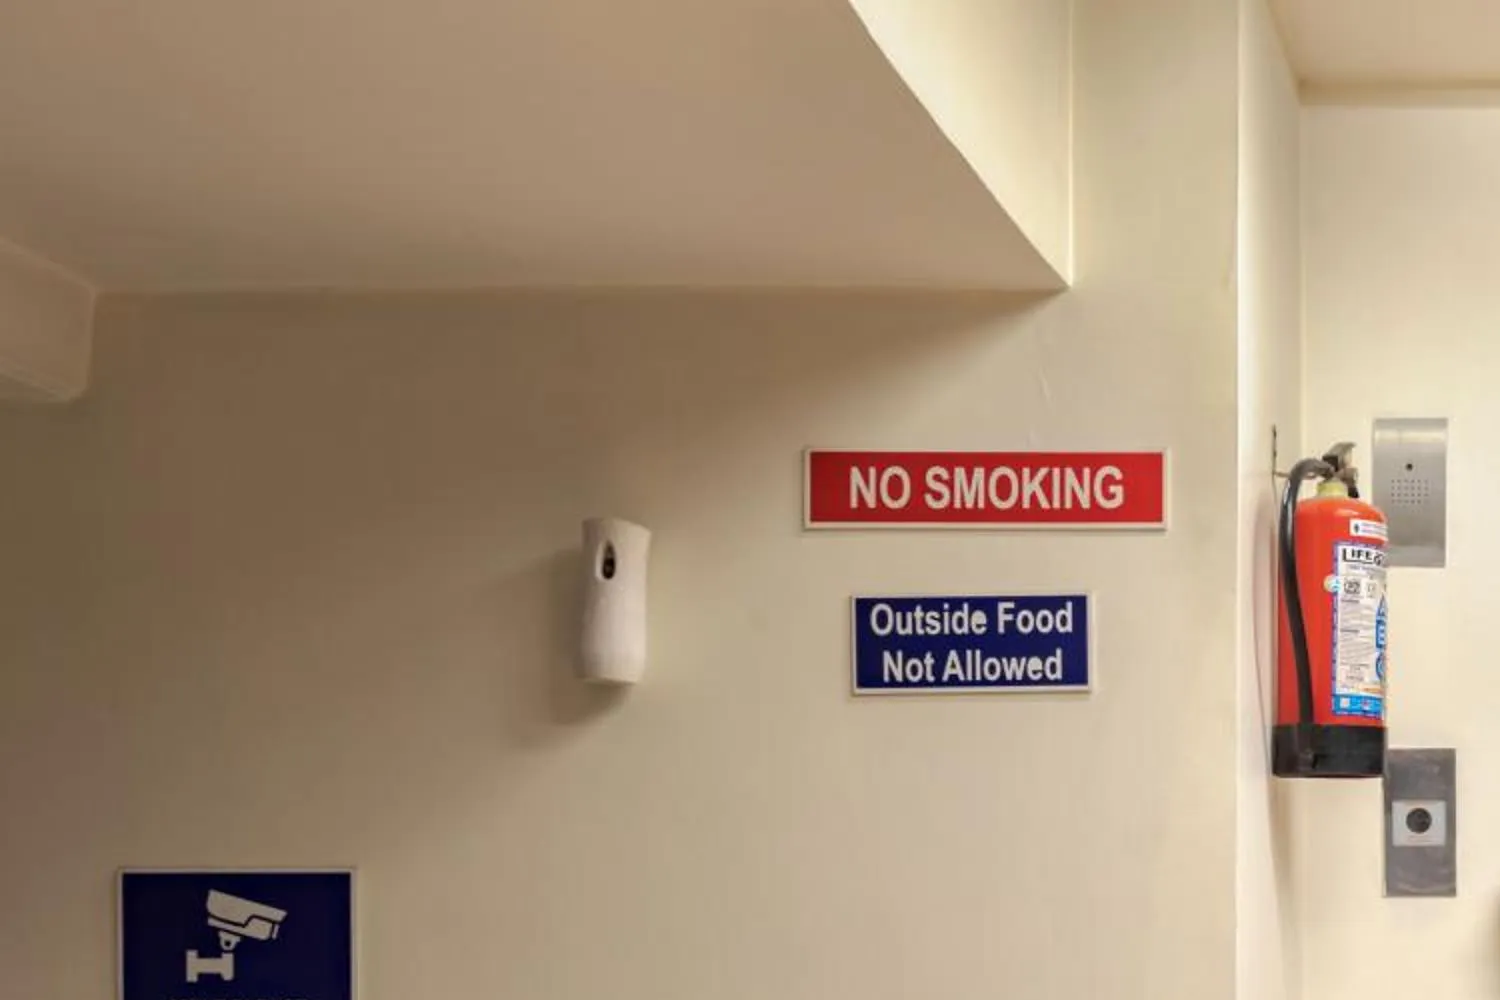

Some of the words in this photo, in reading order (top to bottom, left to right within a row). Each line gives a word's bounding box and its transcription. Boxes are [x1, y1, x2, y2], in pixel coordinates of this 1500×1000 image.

[850, 465, 911, 509] NO
[924, 465, 1124, 509] SMOKING
[870, 602, 987, 635] Outside
[998, 601, 1073, 634] Food
[883, 650, 934, 683] Not
[942, 649, 1063, 682] Allowed
